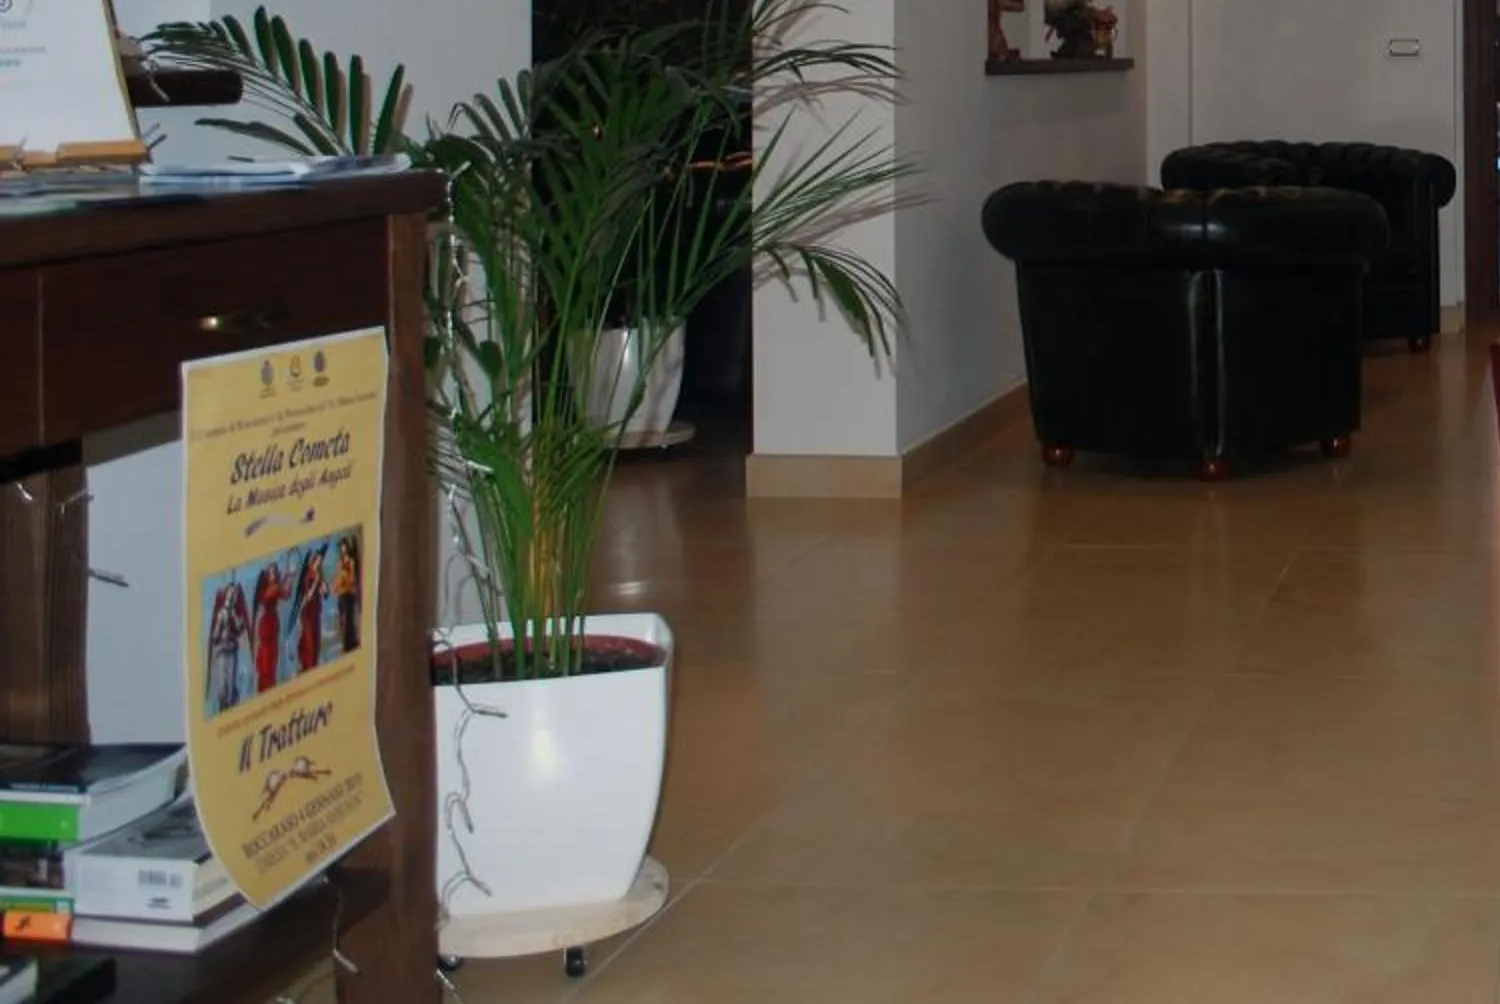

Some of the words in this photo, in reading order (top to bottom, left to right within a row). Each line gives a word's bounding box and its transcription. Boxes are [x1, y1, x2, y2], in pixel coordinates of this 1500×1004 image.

[230, 443, 284, 484] Stella
[289, 427, 350, 468] Cometa
[227, 495, 242, 515] La
[239, 736, 254, 772] Il
